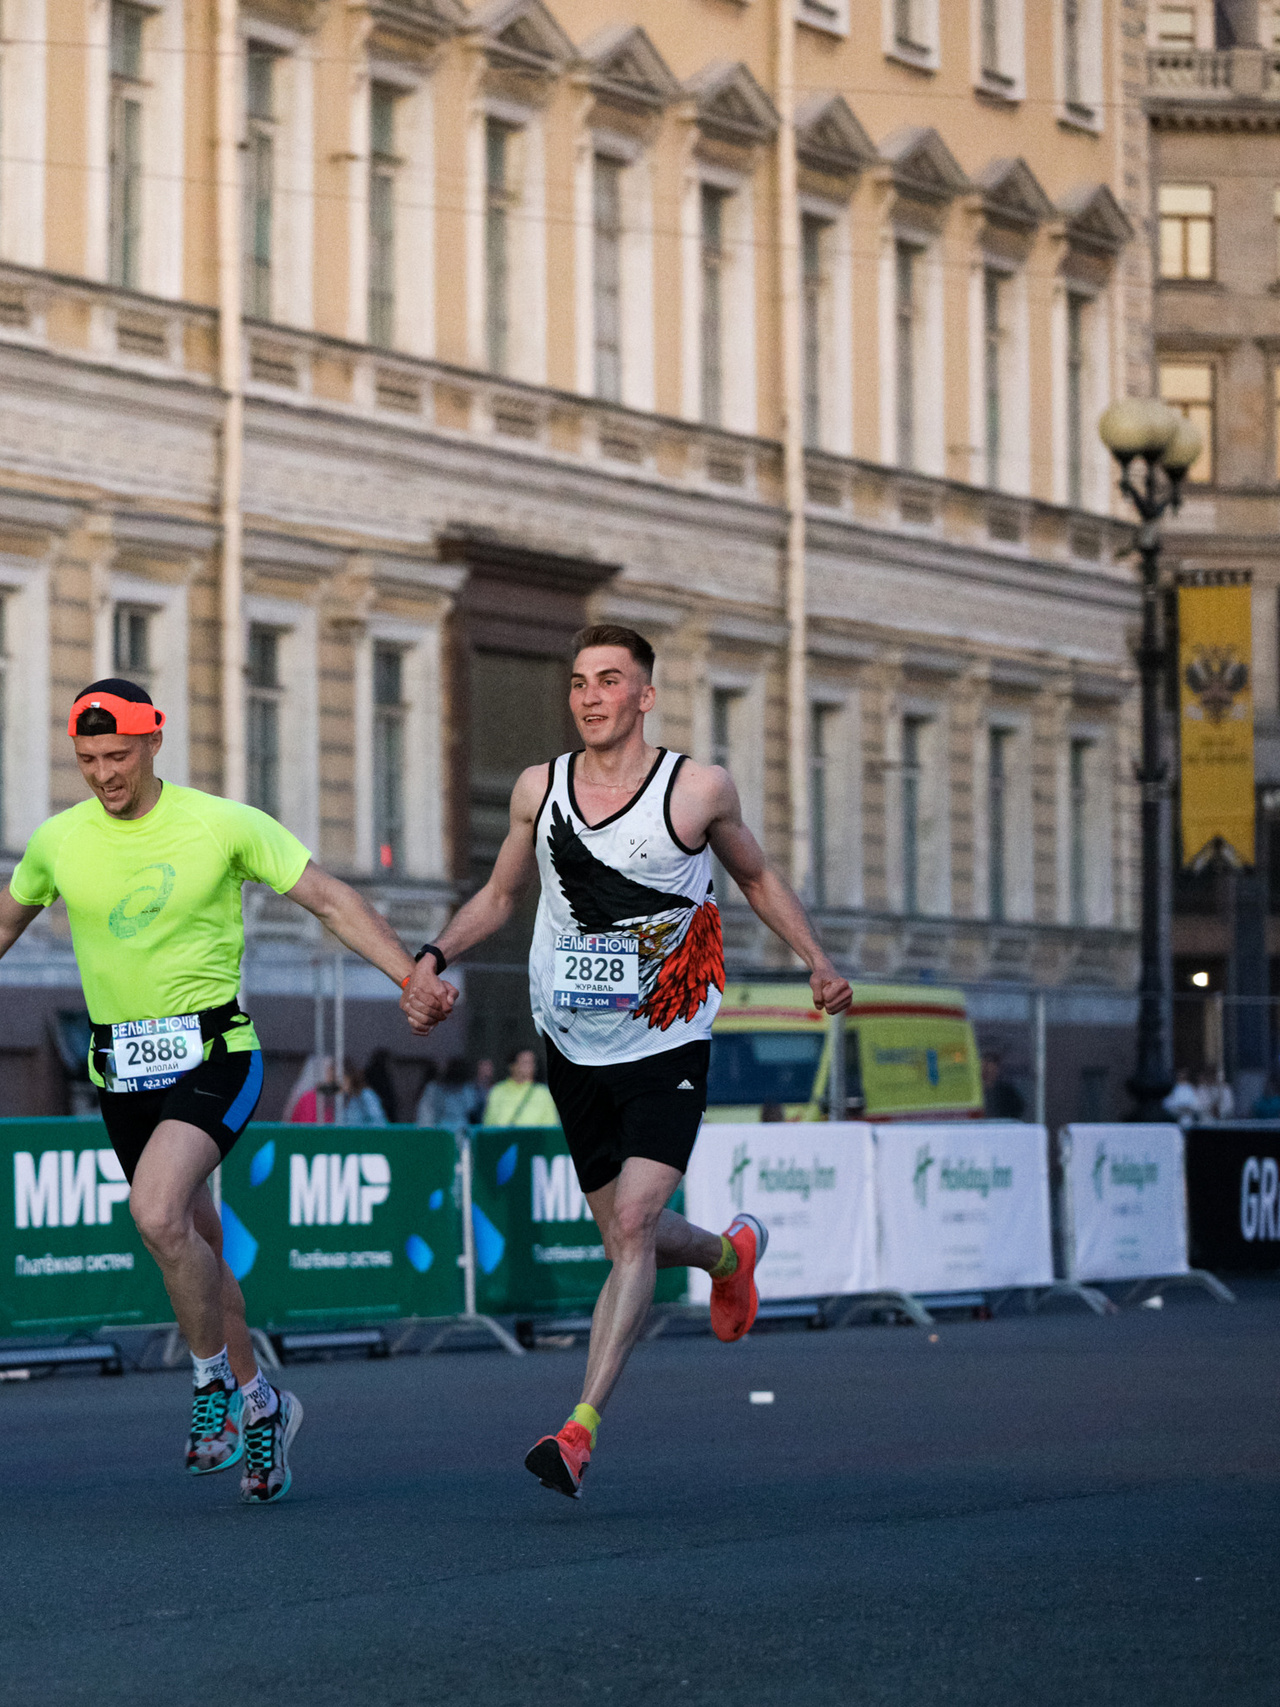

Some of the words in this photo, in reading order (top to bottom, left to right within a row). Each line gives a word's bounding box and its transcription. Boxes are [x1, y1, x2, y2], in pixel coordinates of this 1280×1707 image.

[556, 935, 593, 952] БЕЛЫЕ
[595, 939, 639, 953] НОЧИ
[565, 955, 625, 983] 2828
[574, 983, 614, 993] ЖУРАВЛЬ
[594, 998, 610, 1007] КМ
[111, 1020, 154, 1038] БЕЛЫЕ
[125, 1035, 189, 1067] 2888
[162, 1077, 177, 1086] КМ
[289, 1153, 391, 1226] МИР
